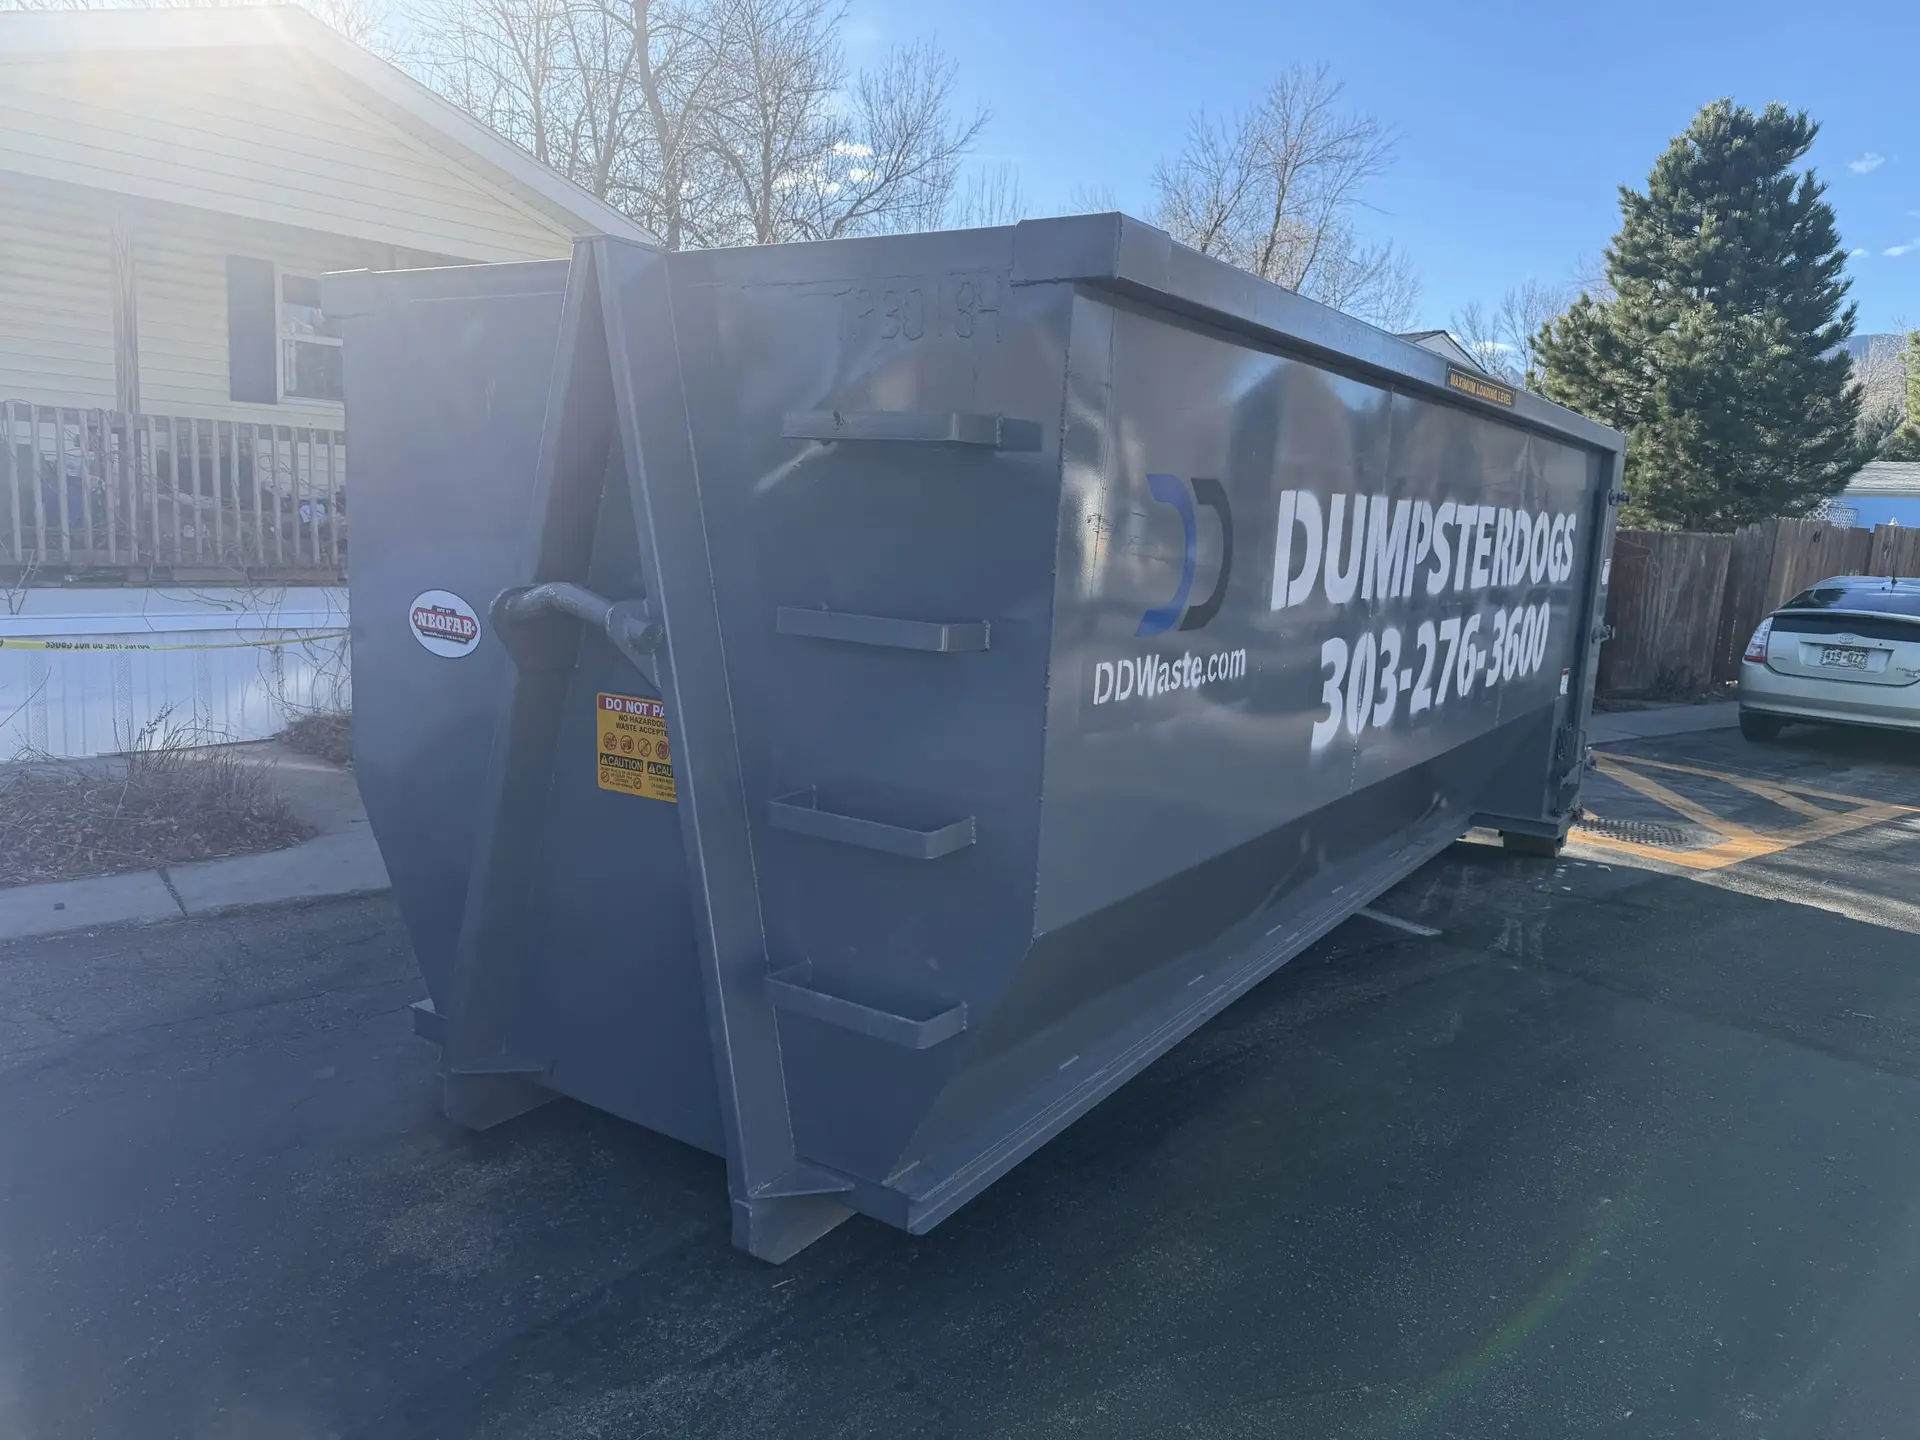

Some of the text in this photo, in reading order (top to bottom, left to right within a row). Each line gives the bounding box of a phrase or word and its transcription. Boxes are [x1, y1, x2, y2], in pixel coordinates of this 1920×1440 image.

[1498, 391, 1512, 406] LEVEL
[1270, 489, 1577, 611] DUMPSTERDOGS
[417, 611, 472, 635] NEOFAB
[1094, 647, 1247, 705] DDWaste.com
[1310, 602, 1550, 750] 303-276-3600
[605, 697, 622, 711] DO
[625, 700, 648, 715] NOT
[616, 722, 637, 732] WASTE
[618, 714, 667, 729] NO HAZARDOU
[608, 756, 642, 771] CAUTION
